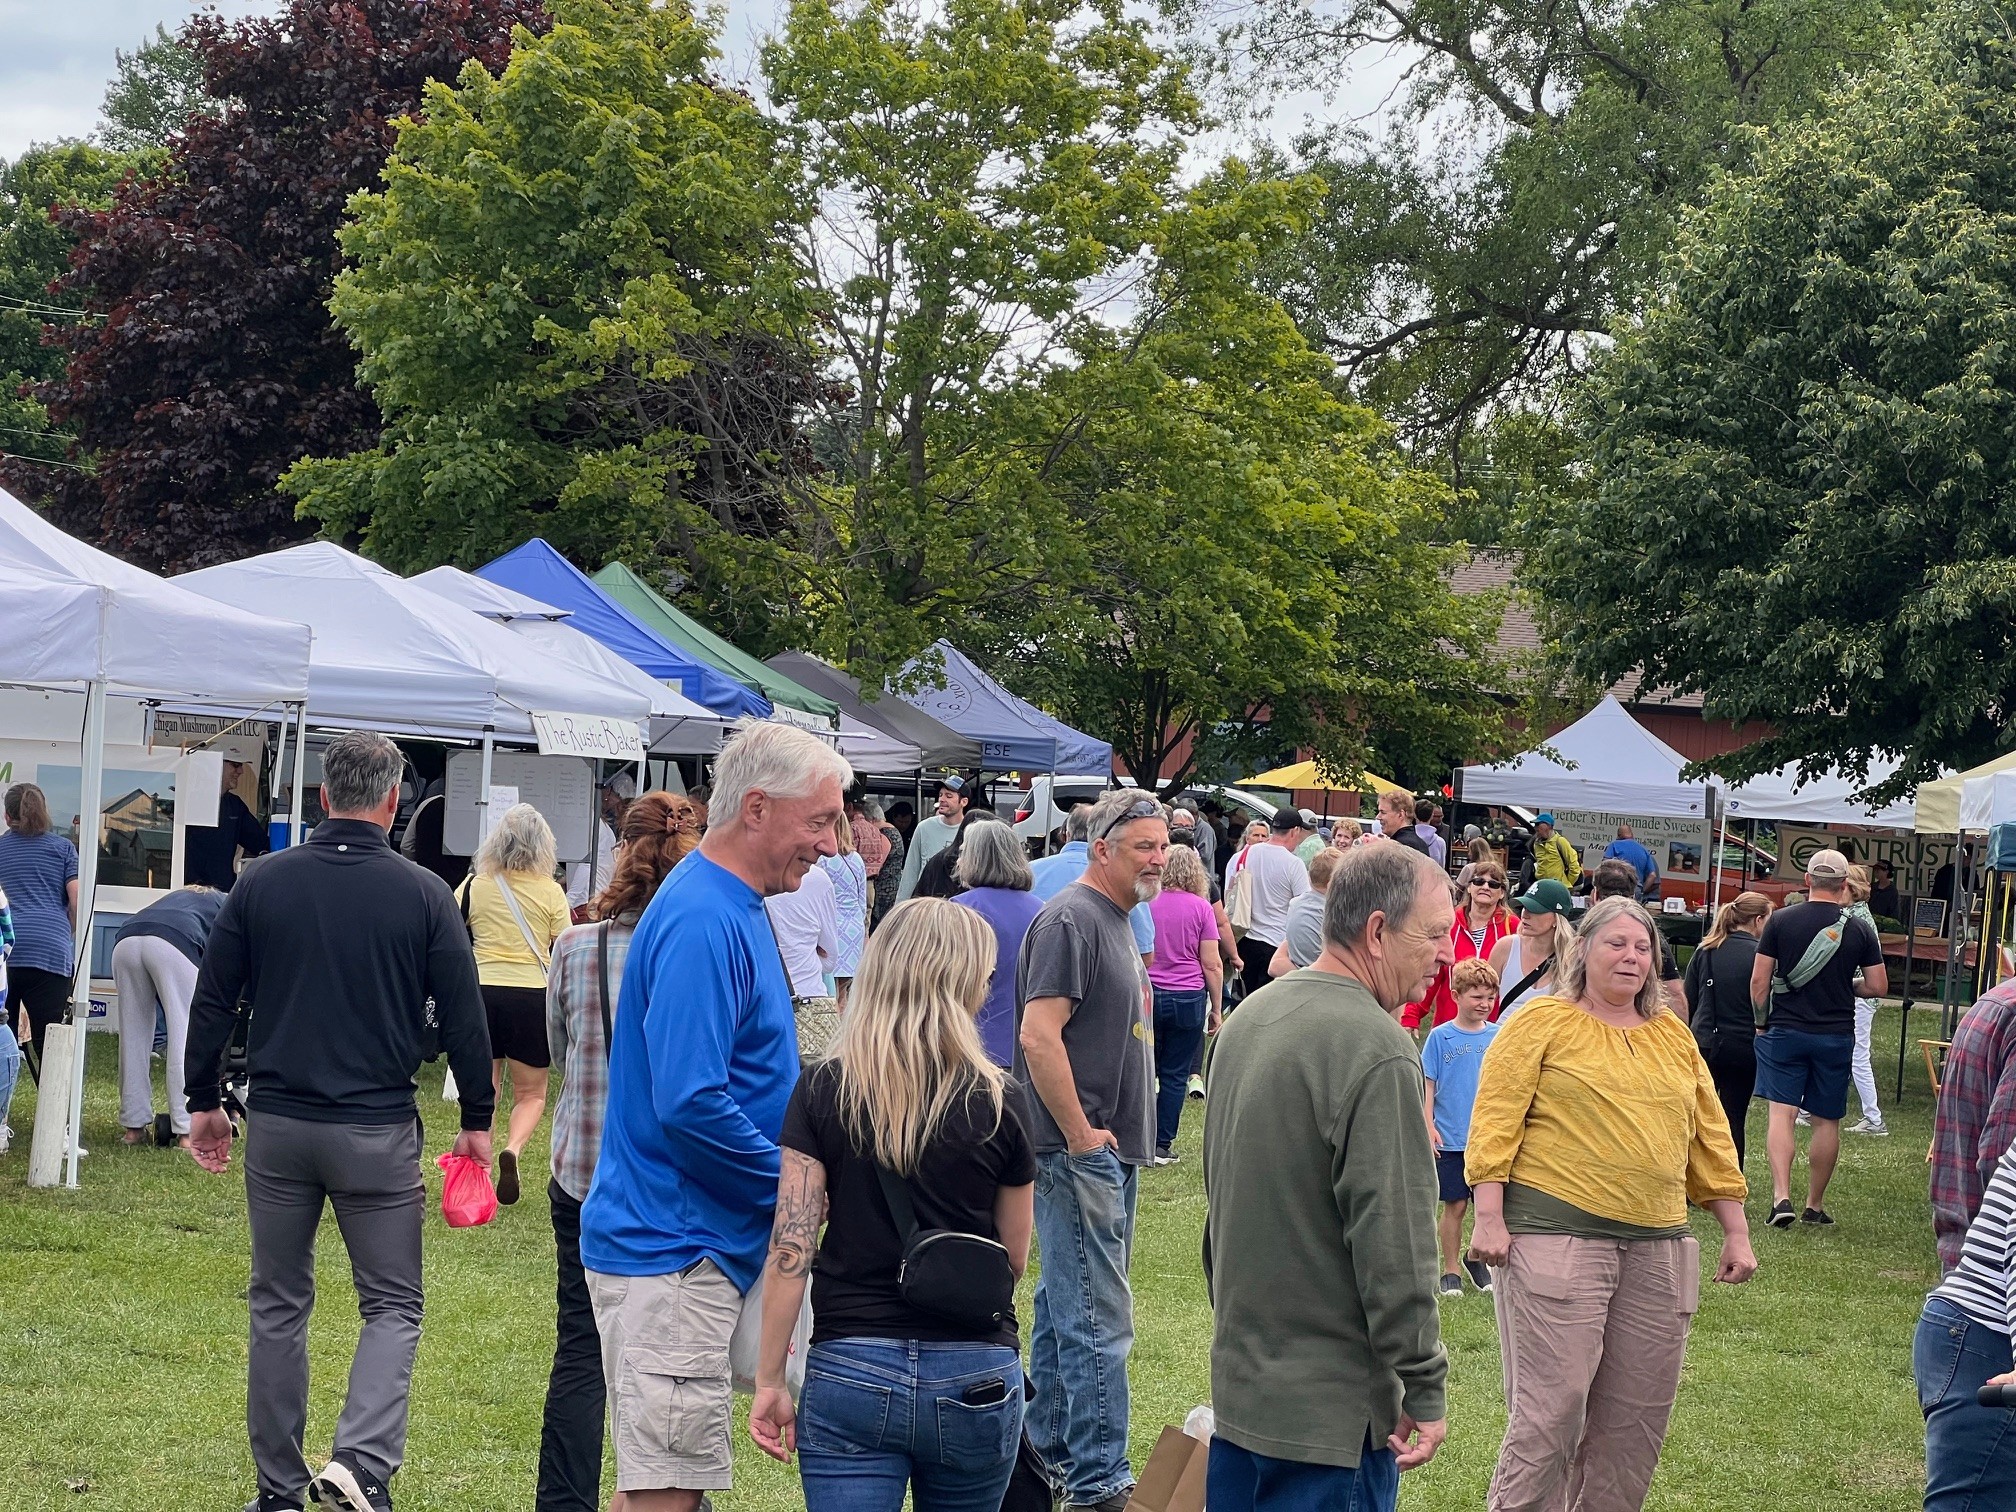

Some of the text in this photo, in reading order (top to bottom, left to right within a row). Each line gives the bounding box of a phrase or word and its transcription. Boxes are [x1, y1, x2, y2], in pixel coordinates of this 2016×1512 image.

[154, 713, 178, 737] chigan
[179, 716, 217, 734] Mushroom
[243, 720, 260, 737] LLC
[534, 714, 639, 755] The Rustic Baker
[984, 743, 1011, 757] ESE
[1599, 813, 1660, 830] Homemade
[1663, 817, 1702, 833] Sweets
[1443, 1042, 1472, 1064] BLUE
